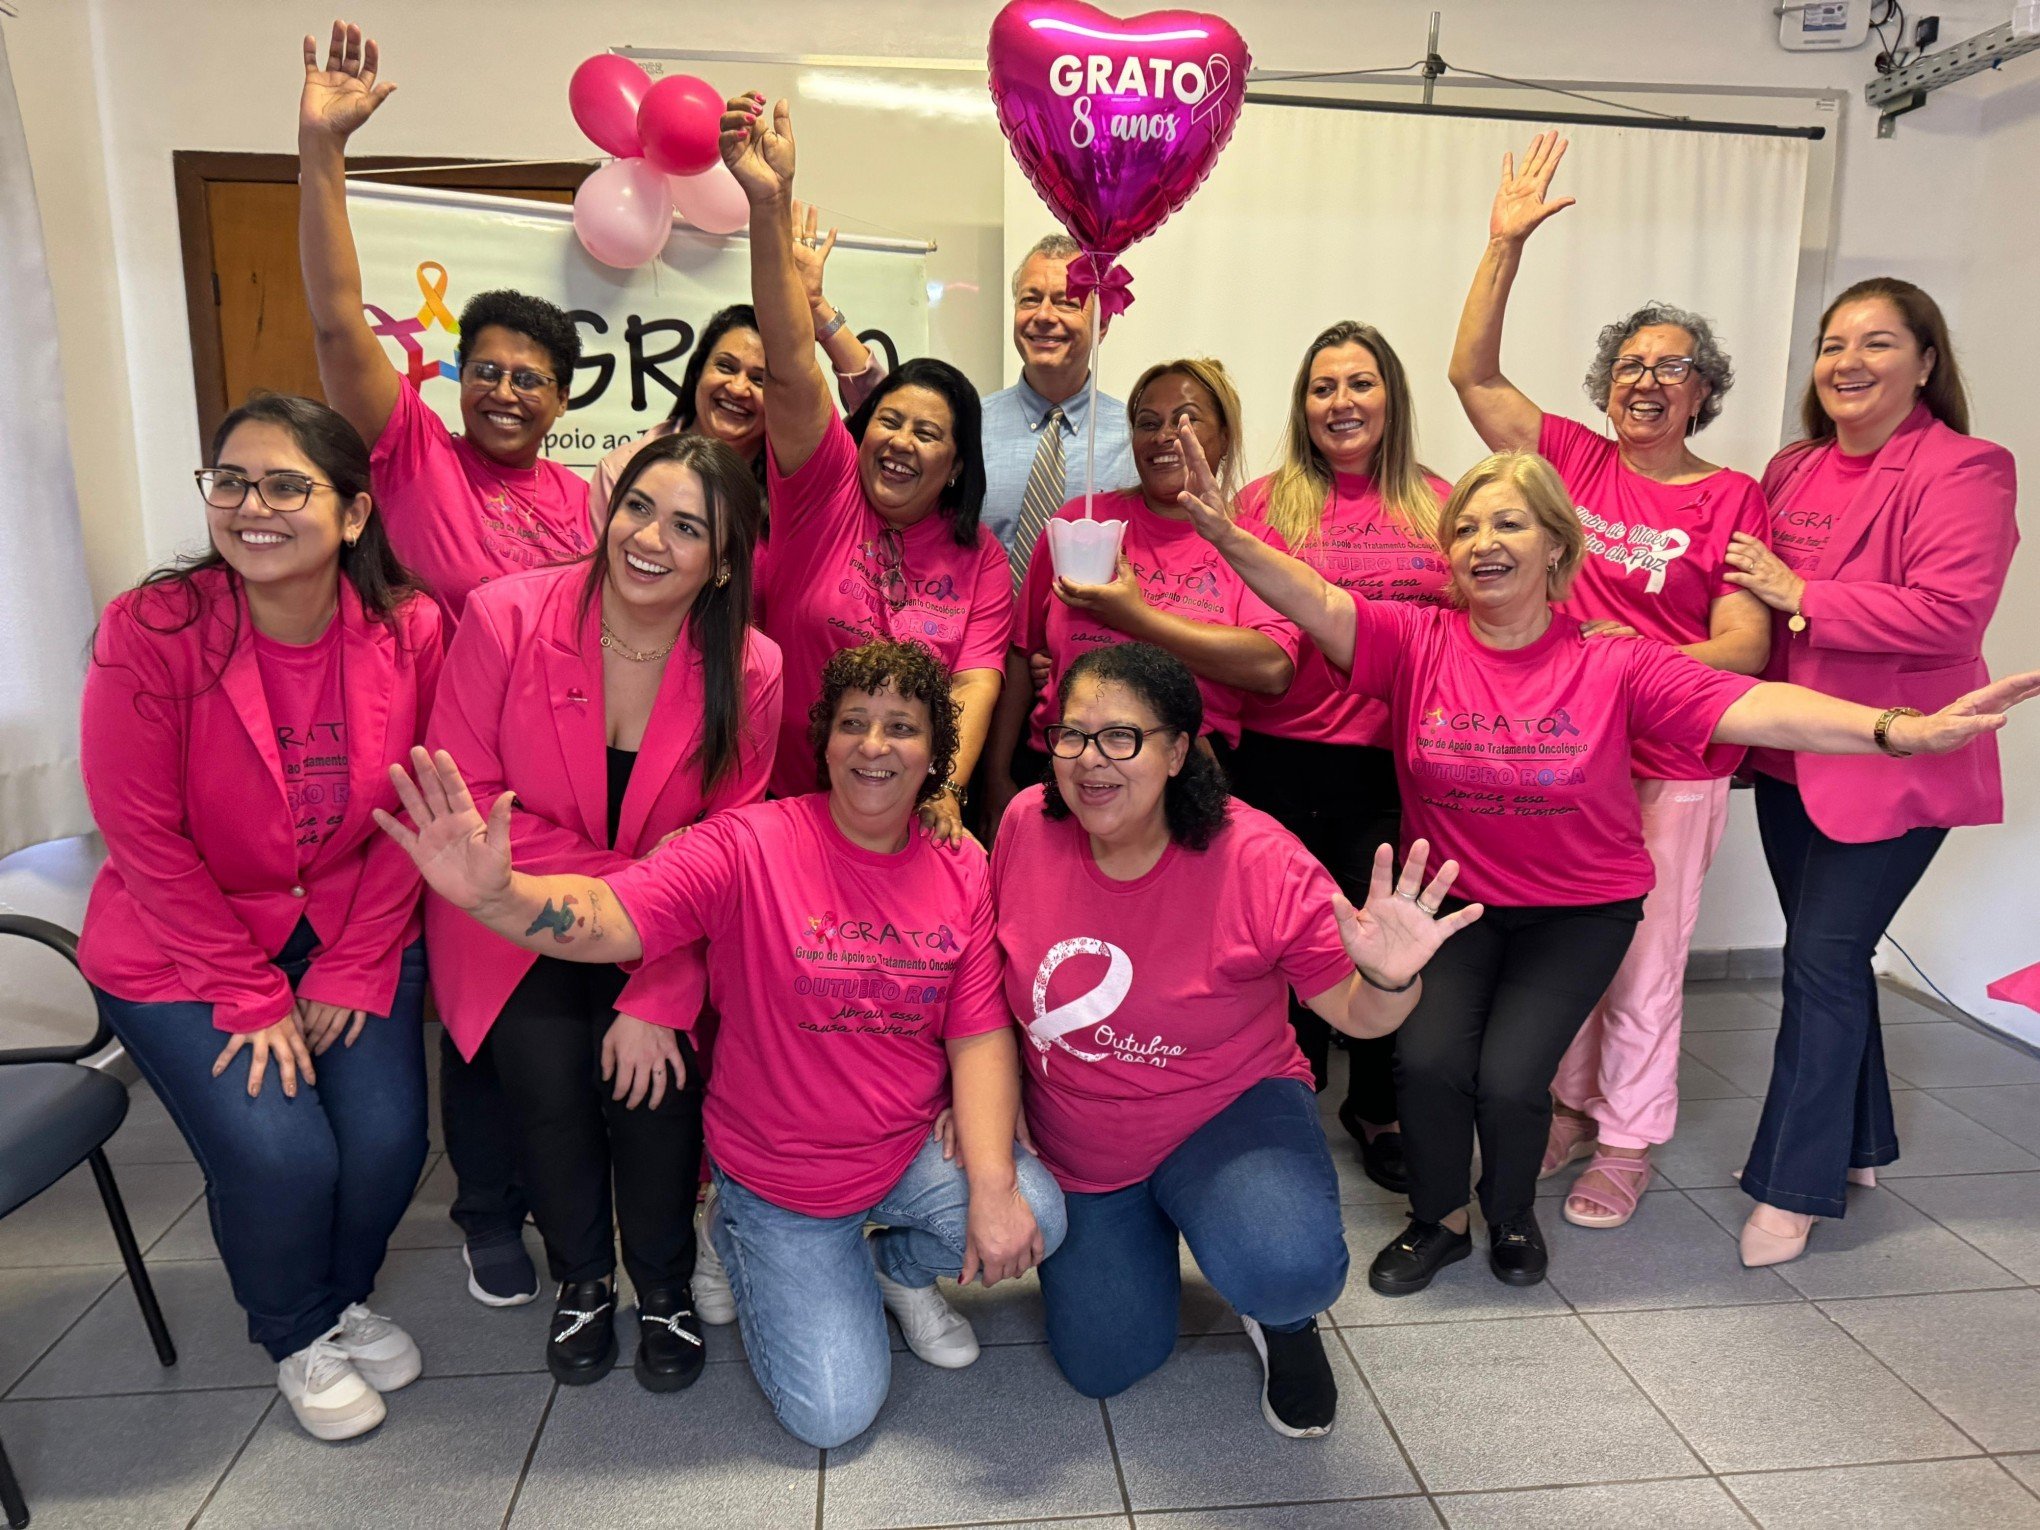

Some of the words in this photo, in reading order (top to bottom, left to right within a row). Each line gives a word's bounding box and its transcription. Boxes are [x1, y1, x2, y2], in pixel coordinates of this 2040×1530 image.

[1050, 54, 1206, 104] GRATO
[1070, 96, 1095, 148] 8
[1111, 113, 1180, 142] anos
[540, 428, 595, 457] poio
[602, 433, 631, 450] ao
[1605, 521, 1627, 540] de
[1789, 511, 1832, 530] GRA
[1629, 547, 1668, 573] Paz
[1127, 562, 1203, 590] RATO
[1450, 712, 1557, 735] GRATO
[1475, 742, 1485, 752] ao
[1487, 743, 1536, 755] Tratamento
[1539, 743, 1588, 756] Oncológico
[1412, 757, 1514, 786] OUTUBRO
[1520, 766, 1586, 787] ROSA
[839, 920, 943, 949] GRATO
[795, 946, 824, 963] Grupo
[827, 950, 838, 962] de
[841, 950, 865, 965] Apoio
[866, 955, 877, 964] ao
[794, 976, 900, 1001] OUTUBRO
[1094, 1024, 1187, 1056] Outubro
